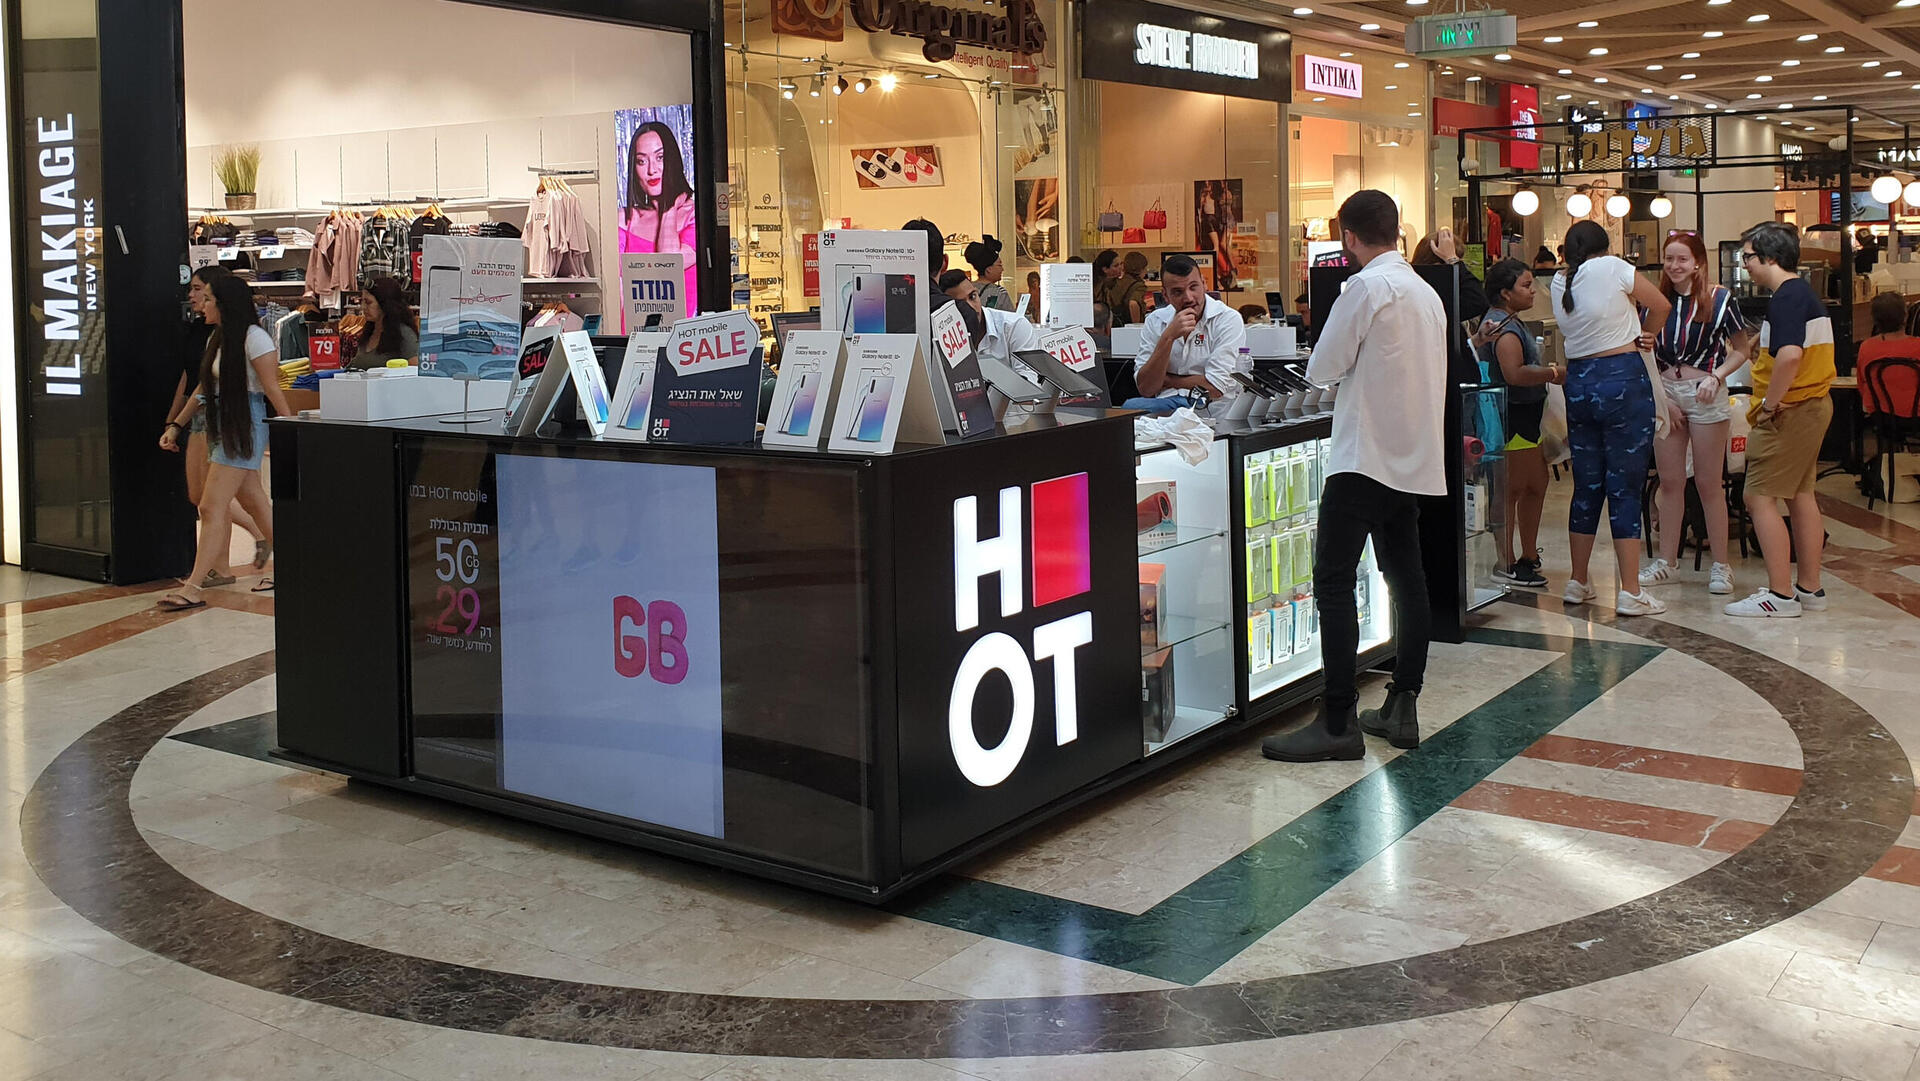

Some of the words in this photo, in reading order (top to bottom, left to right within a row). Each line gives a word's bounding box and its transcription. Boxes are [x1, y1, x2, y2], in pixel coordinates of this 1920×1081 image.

[1134, 22, 1191, 69] STEVE
[1311, 62, 1358, 91] INTIMA
[37, 113, 80, 341] MAKIAGE
[83, 198, 95, 257] YORK
[864, 247, 886, 255] Galaxy
[86, 263, 97, 311] NEW
[631, 280, 676, 301] תודה
[678, 327, 697, 339] HOT
[698, 322, 728, 335] mobile
[942, 321, 968, 358] SALE
[678, 330, 748, 367] SALE
[45, 353, 82, 396] IL
[667, 389, 698, 401] הנציג
[700, 389, 717, 400] את
[719, 388, 743, 400] שאל
[429, 486, 451, 500] HOT
[452, 490, 488, 503] mobile
[463, 522, 489, 535] תכנית
[435, 584, 481, 636] 29
[479, 625, 493, 639] רק
[613, 595, 690, 685] GB
